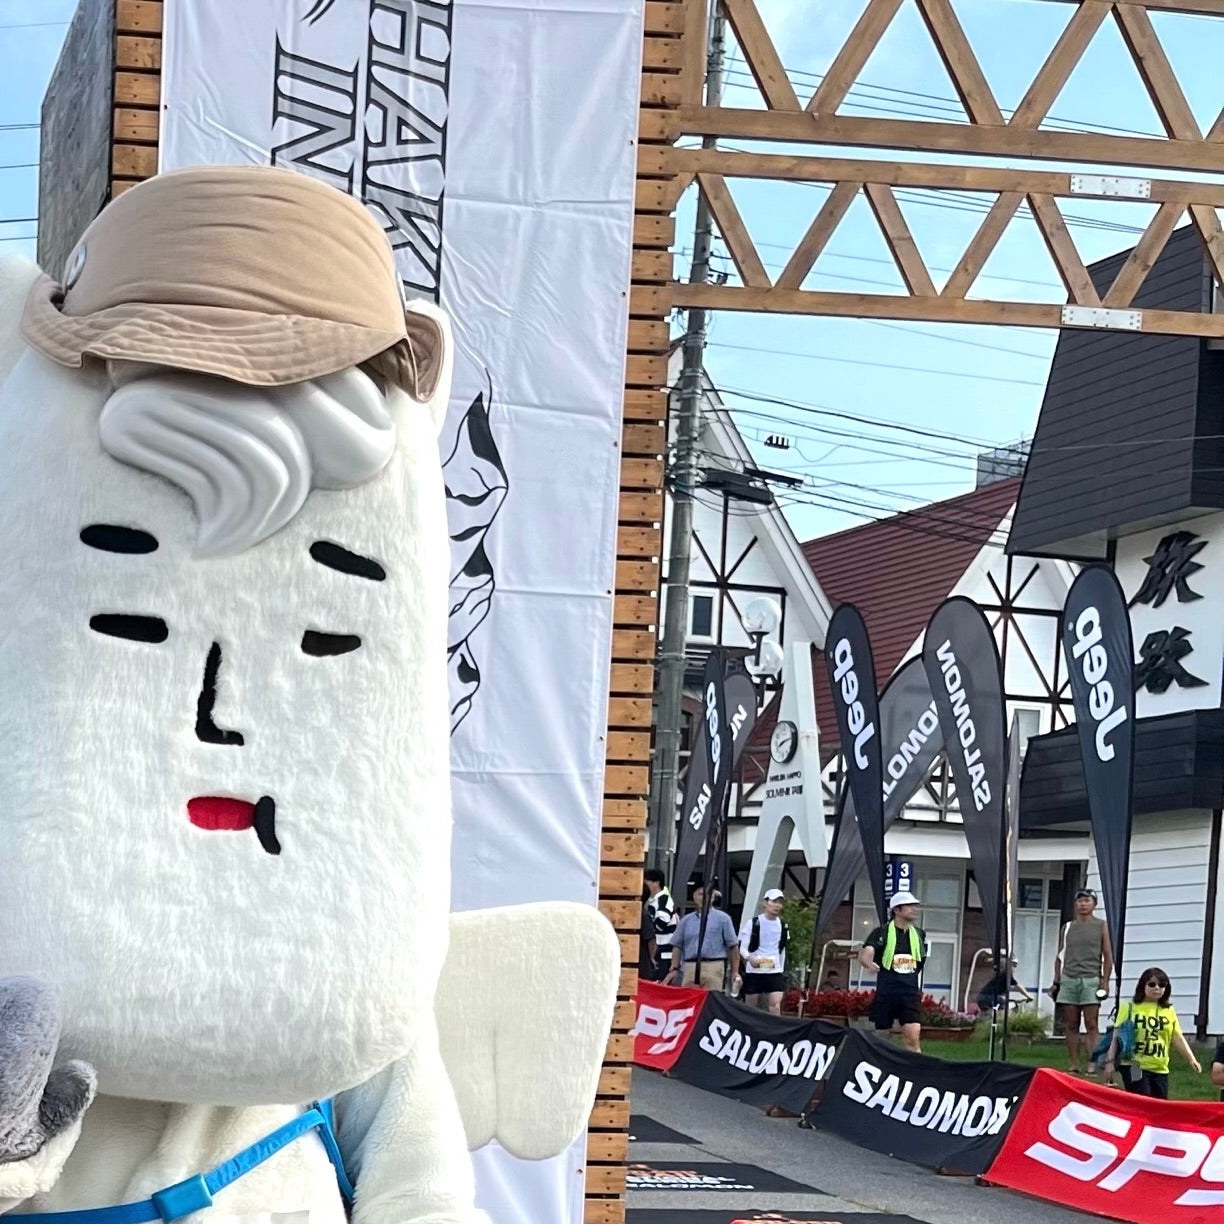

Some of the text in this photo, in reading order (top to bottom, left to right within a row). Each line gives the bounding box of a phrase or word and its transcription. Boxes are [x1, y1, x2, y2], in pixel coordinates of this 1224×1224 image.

[883, 700, 938, 802] LOMO
[886, 863, 893, 877] 3
[900, 862, 909, 877] 3
[1134, 1013, 1169, 1031] HOP
[1145, 1029, 1158, 1041] IS
[1135, 1041, 1165, 1058] FUN
